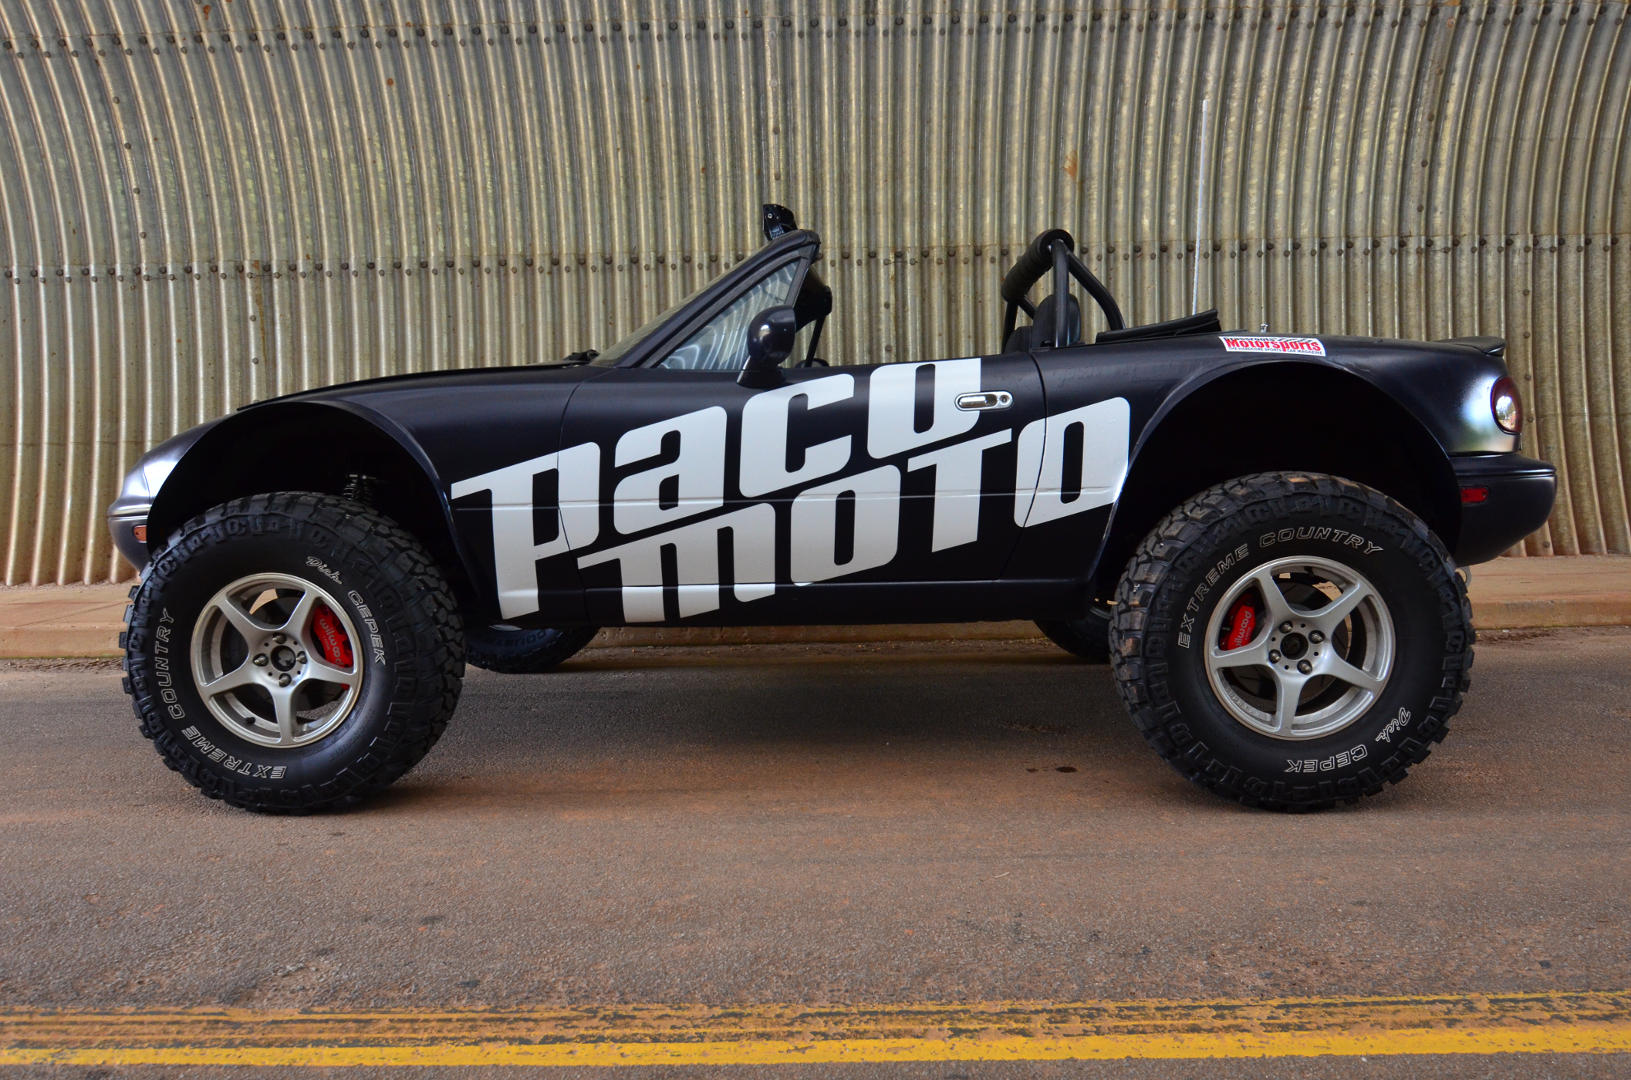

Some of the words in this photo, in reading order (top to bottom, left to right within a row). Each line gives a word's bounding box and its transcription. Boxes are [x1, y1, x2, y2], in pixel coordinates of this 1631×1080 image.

[1223, 339, 1321, 352] Motorsports
[305, 556, 342, 585] Dick
[347, 590, 386, 666] CEPEK
[1178, 543, 1249, 649] EXTREME
[1259, 526, 1384, 555] COUNTRY
[155, 608, 185, 720] COUNTRY
[1375, 707, 1411, 742] Dick
[181, 725, 287, 779] EXTREME
[1284, 744, 1368, 773] CEPEK
